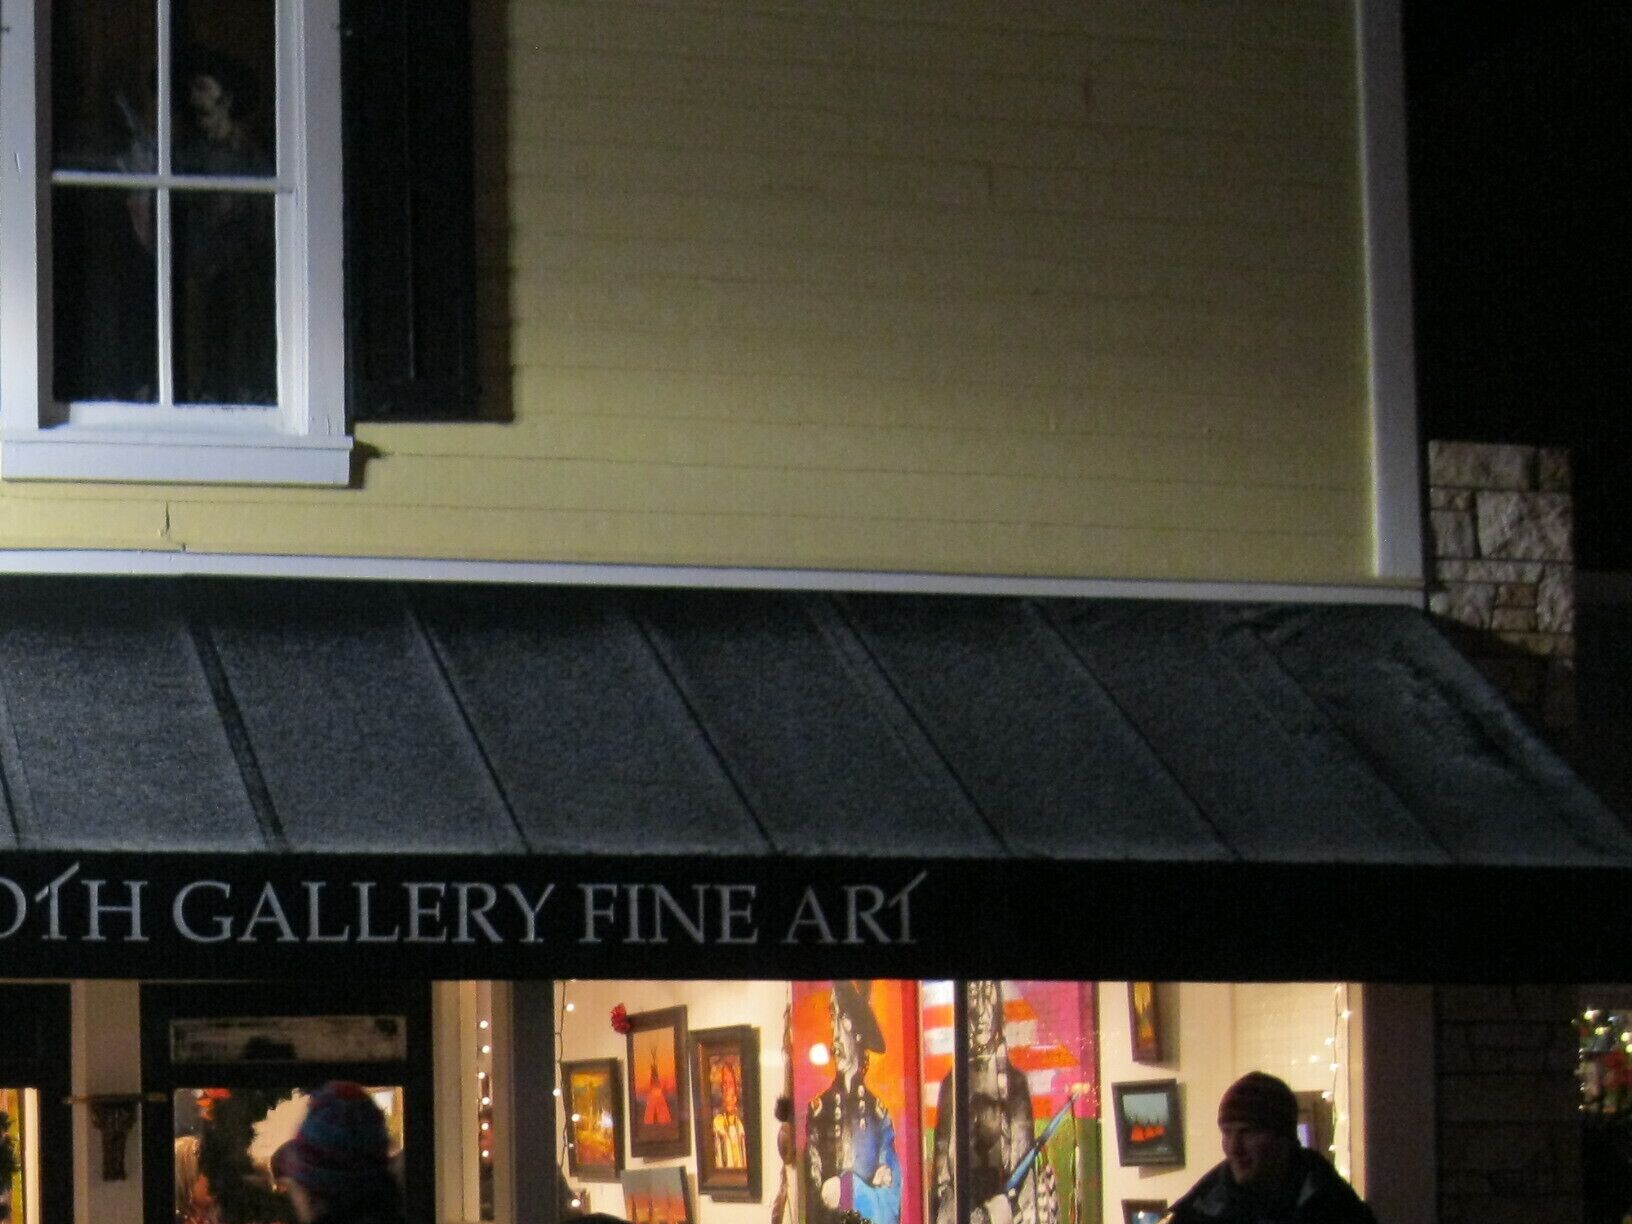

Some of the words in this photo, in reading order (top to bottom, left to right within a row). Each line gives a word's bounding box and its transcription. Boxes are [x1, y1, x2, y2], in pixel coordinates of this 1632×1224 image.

[171, 880, 556, 944] GALLERY
[577, 883, 759, 946] FINE
[779, 869, 928, 946] ART
